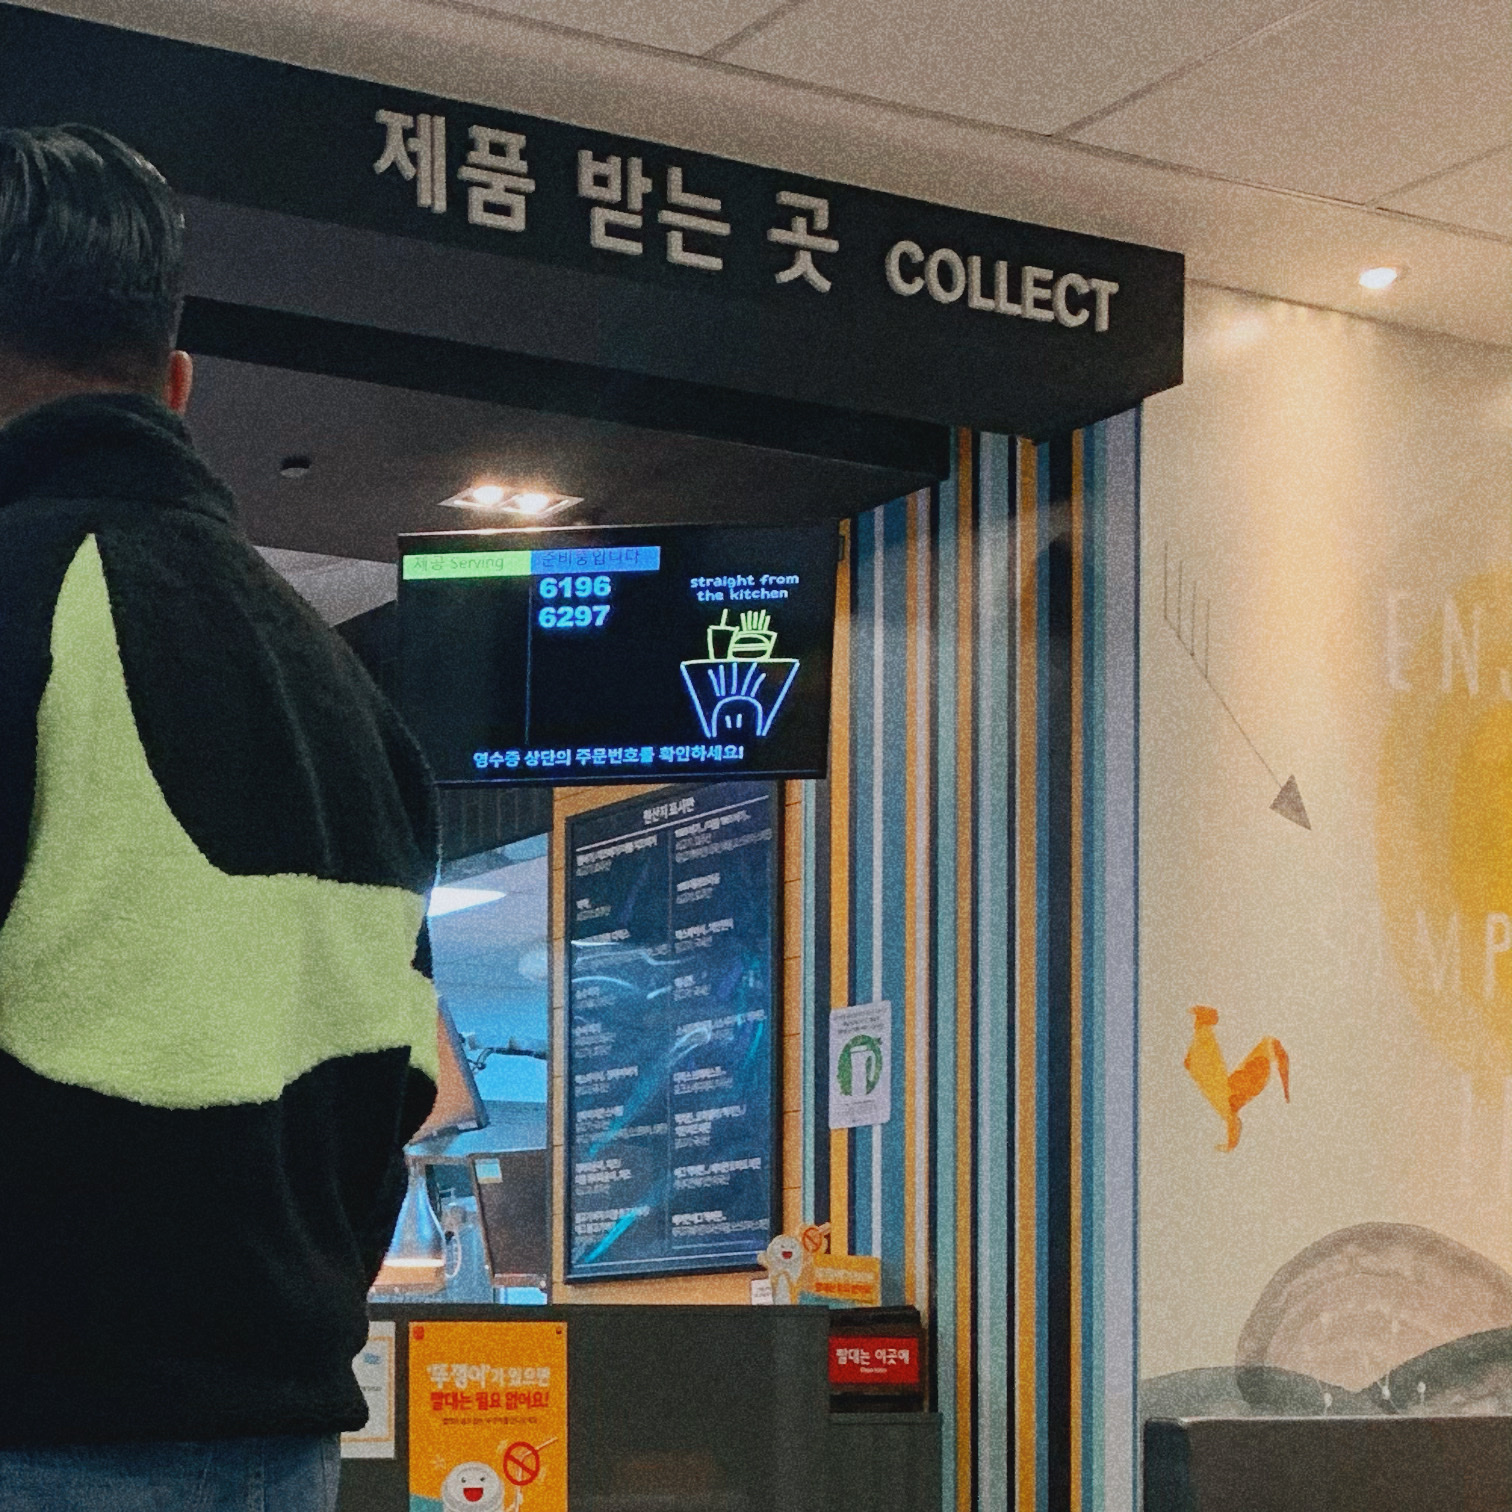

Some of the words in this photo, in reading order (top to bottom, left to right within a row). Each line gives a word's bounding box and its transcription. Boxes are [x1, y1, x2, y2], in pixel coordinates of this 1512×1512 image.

[373, 108, 536, 232] 제품
[577, 148, 732, 272] 받는
[767, 191, 840, 294] 곳
[886, 238, 1120, 333] COLLECT
[412, 557, 447, 573] 제공
[450, 557, 505, 572] Serving
[539, 575, 612, 599] 6196
[690, 574, 756, 589] straight
[759, 573, 800, 586] from
[696, 589, 725, 602] the
[729, 587, 789, 601] kitchen
[538, 604, 612, 629] 6297
[524, 748, 573, 767] 상단의
[575, 747, 656, 767] 주문번호를
[658, 744, 745, 763] 확인하세요!
